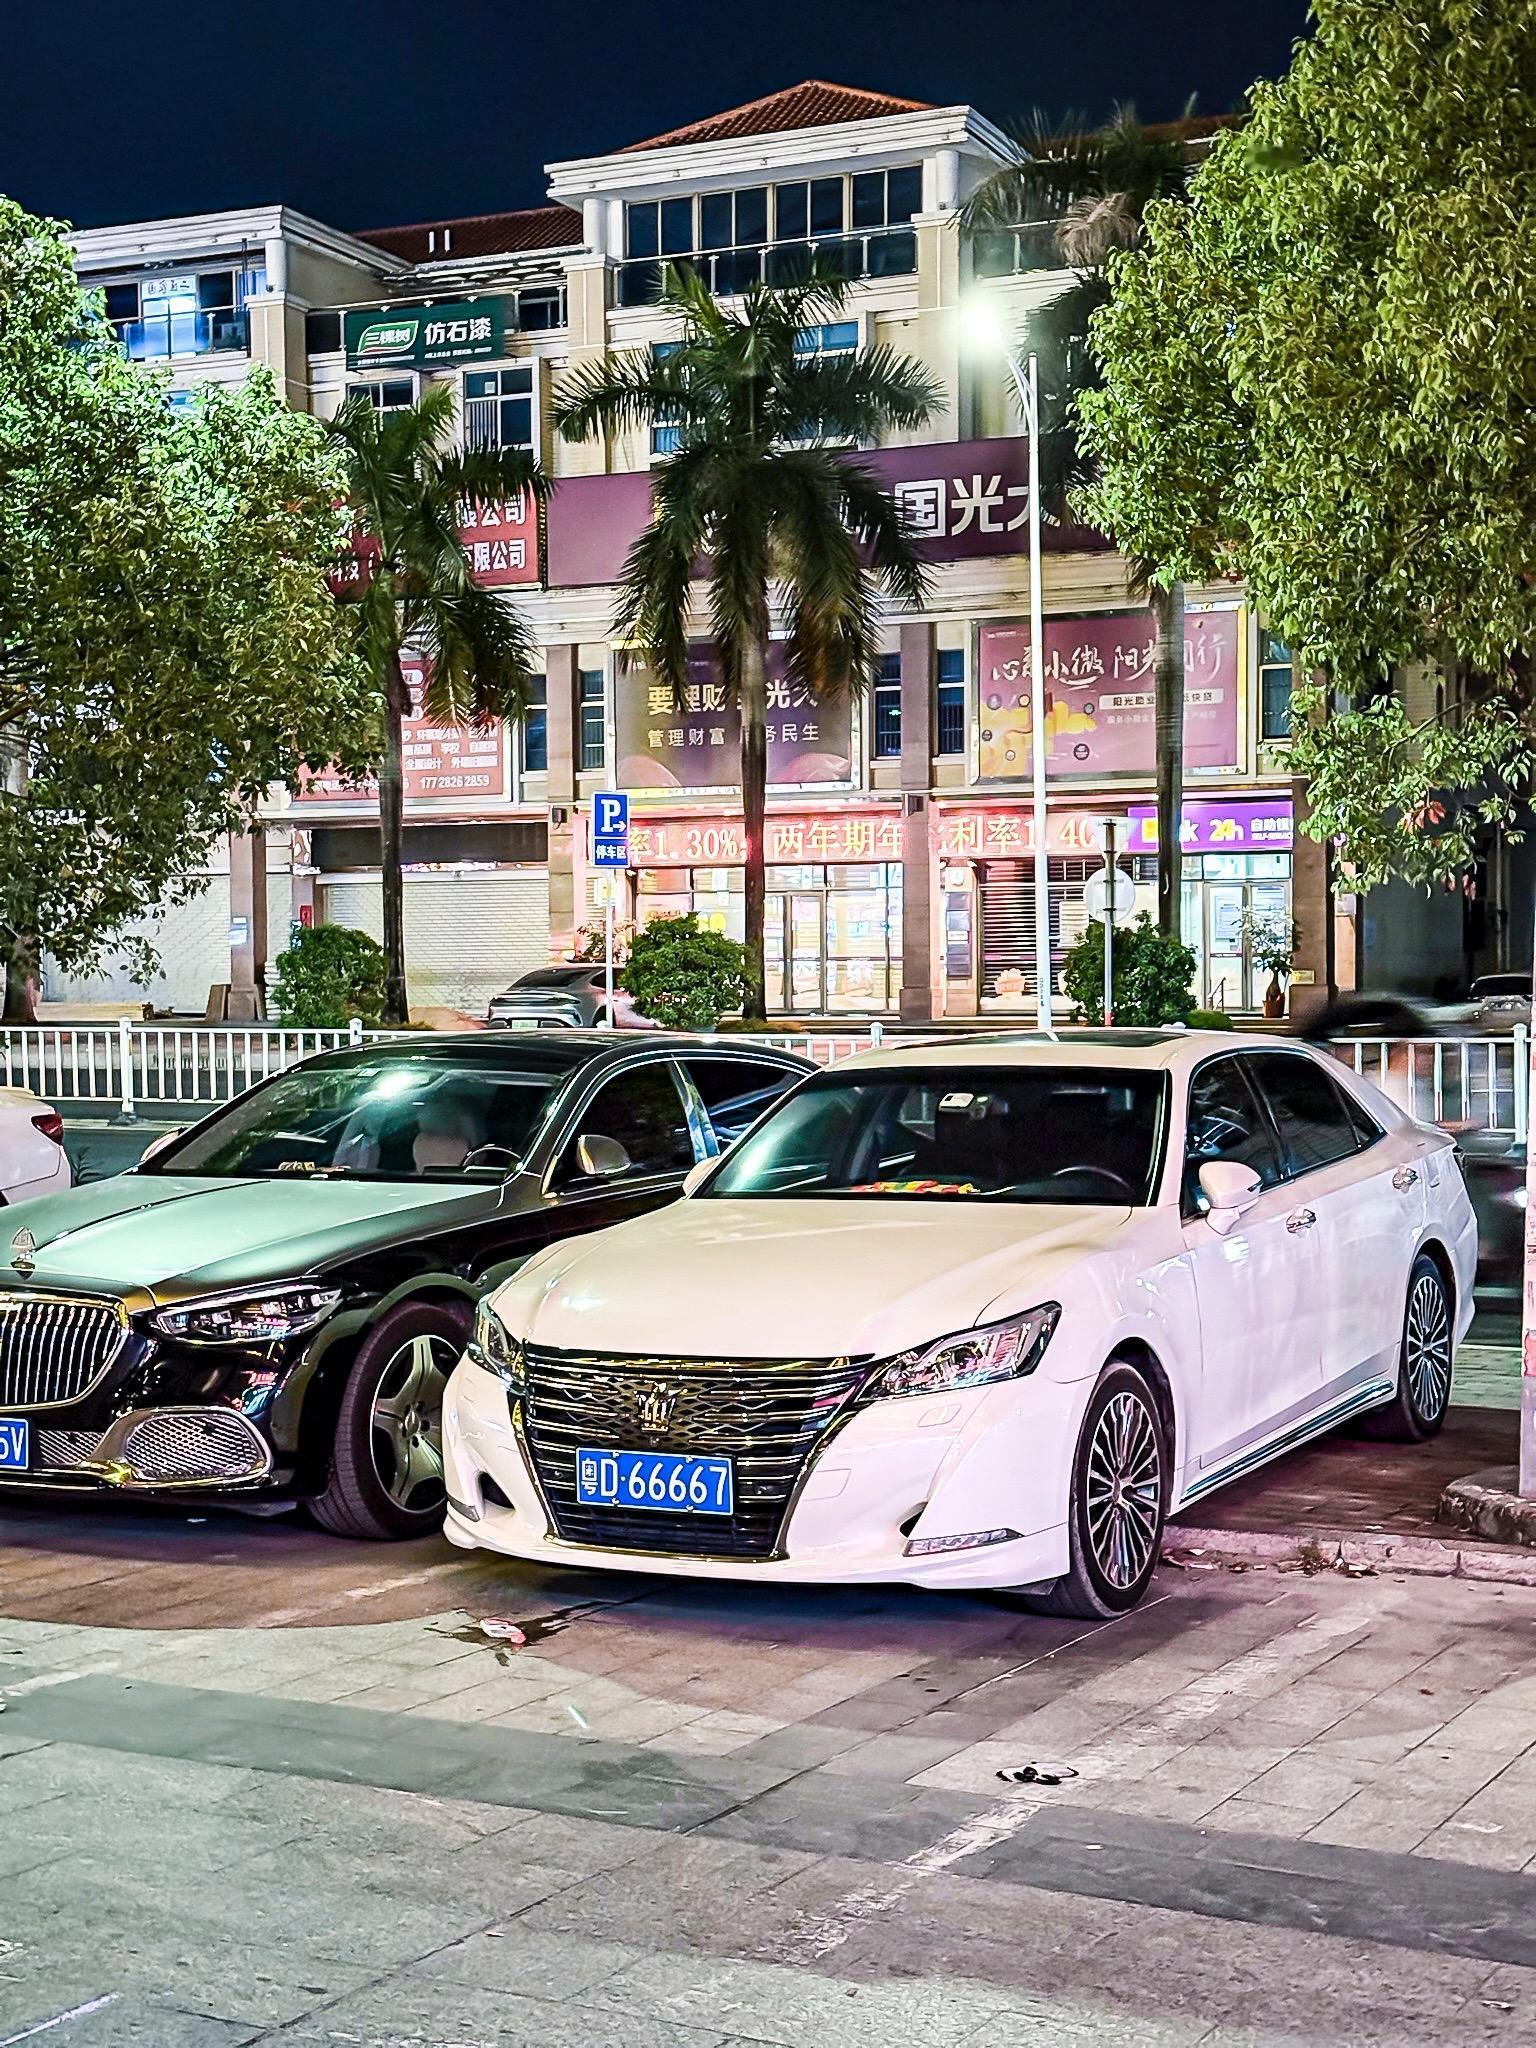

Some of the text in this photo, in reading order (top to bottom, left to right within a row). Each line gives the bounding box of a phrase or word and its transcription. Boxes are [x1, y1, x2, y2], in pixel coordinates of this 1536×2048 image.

[365, 316, 492, 346] 三棵树 仿石漆
[647, 726, 726, 748] 管理财富
[600, 799, 621, 832] P
[1209, 818, 1244, 841] 24h
[596, 845, 627, 860] 停车区
